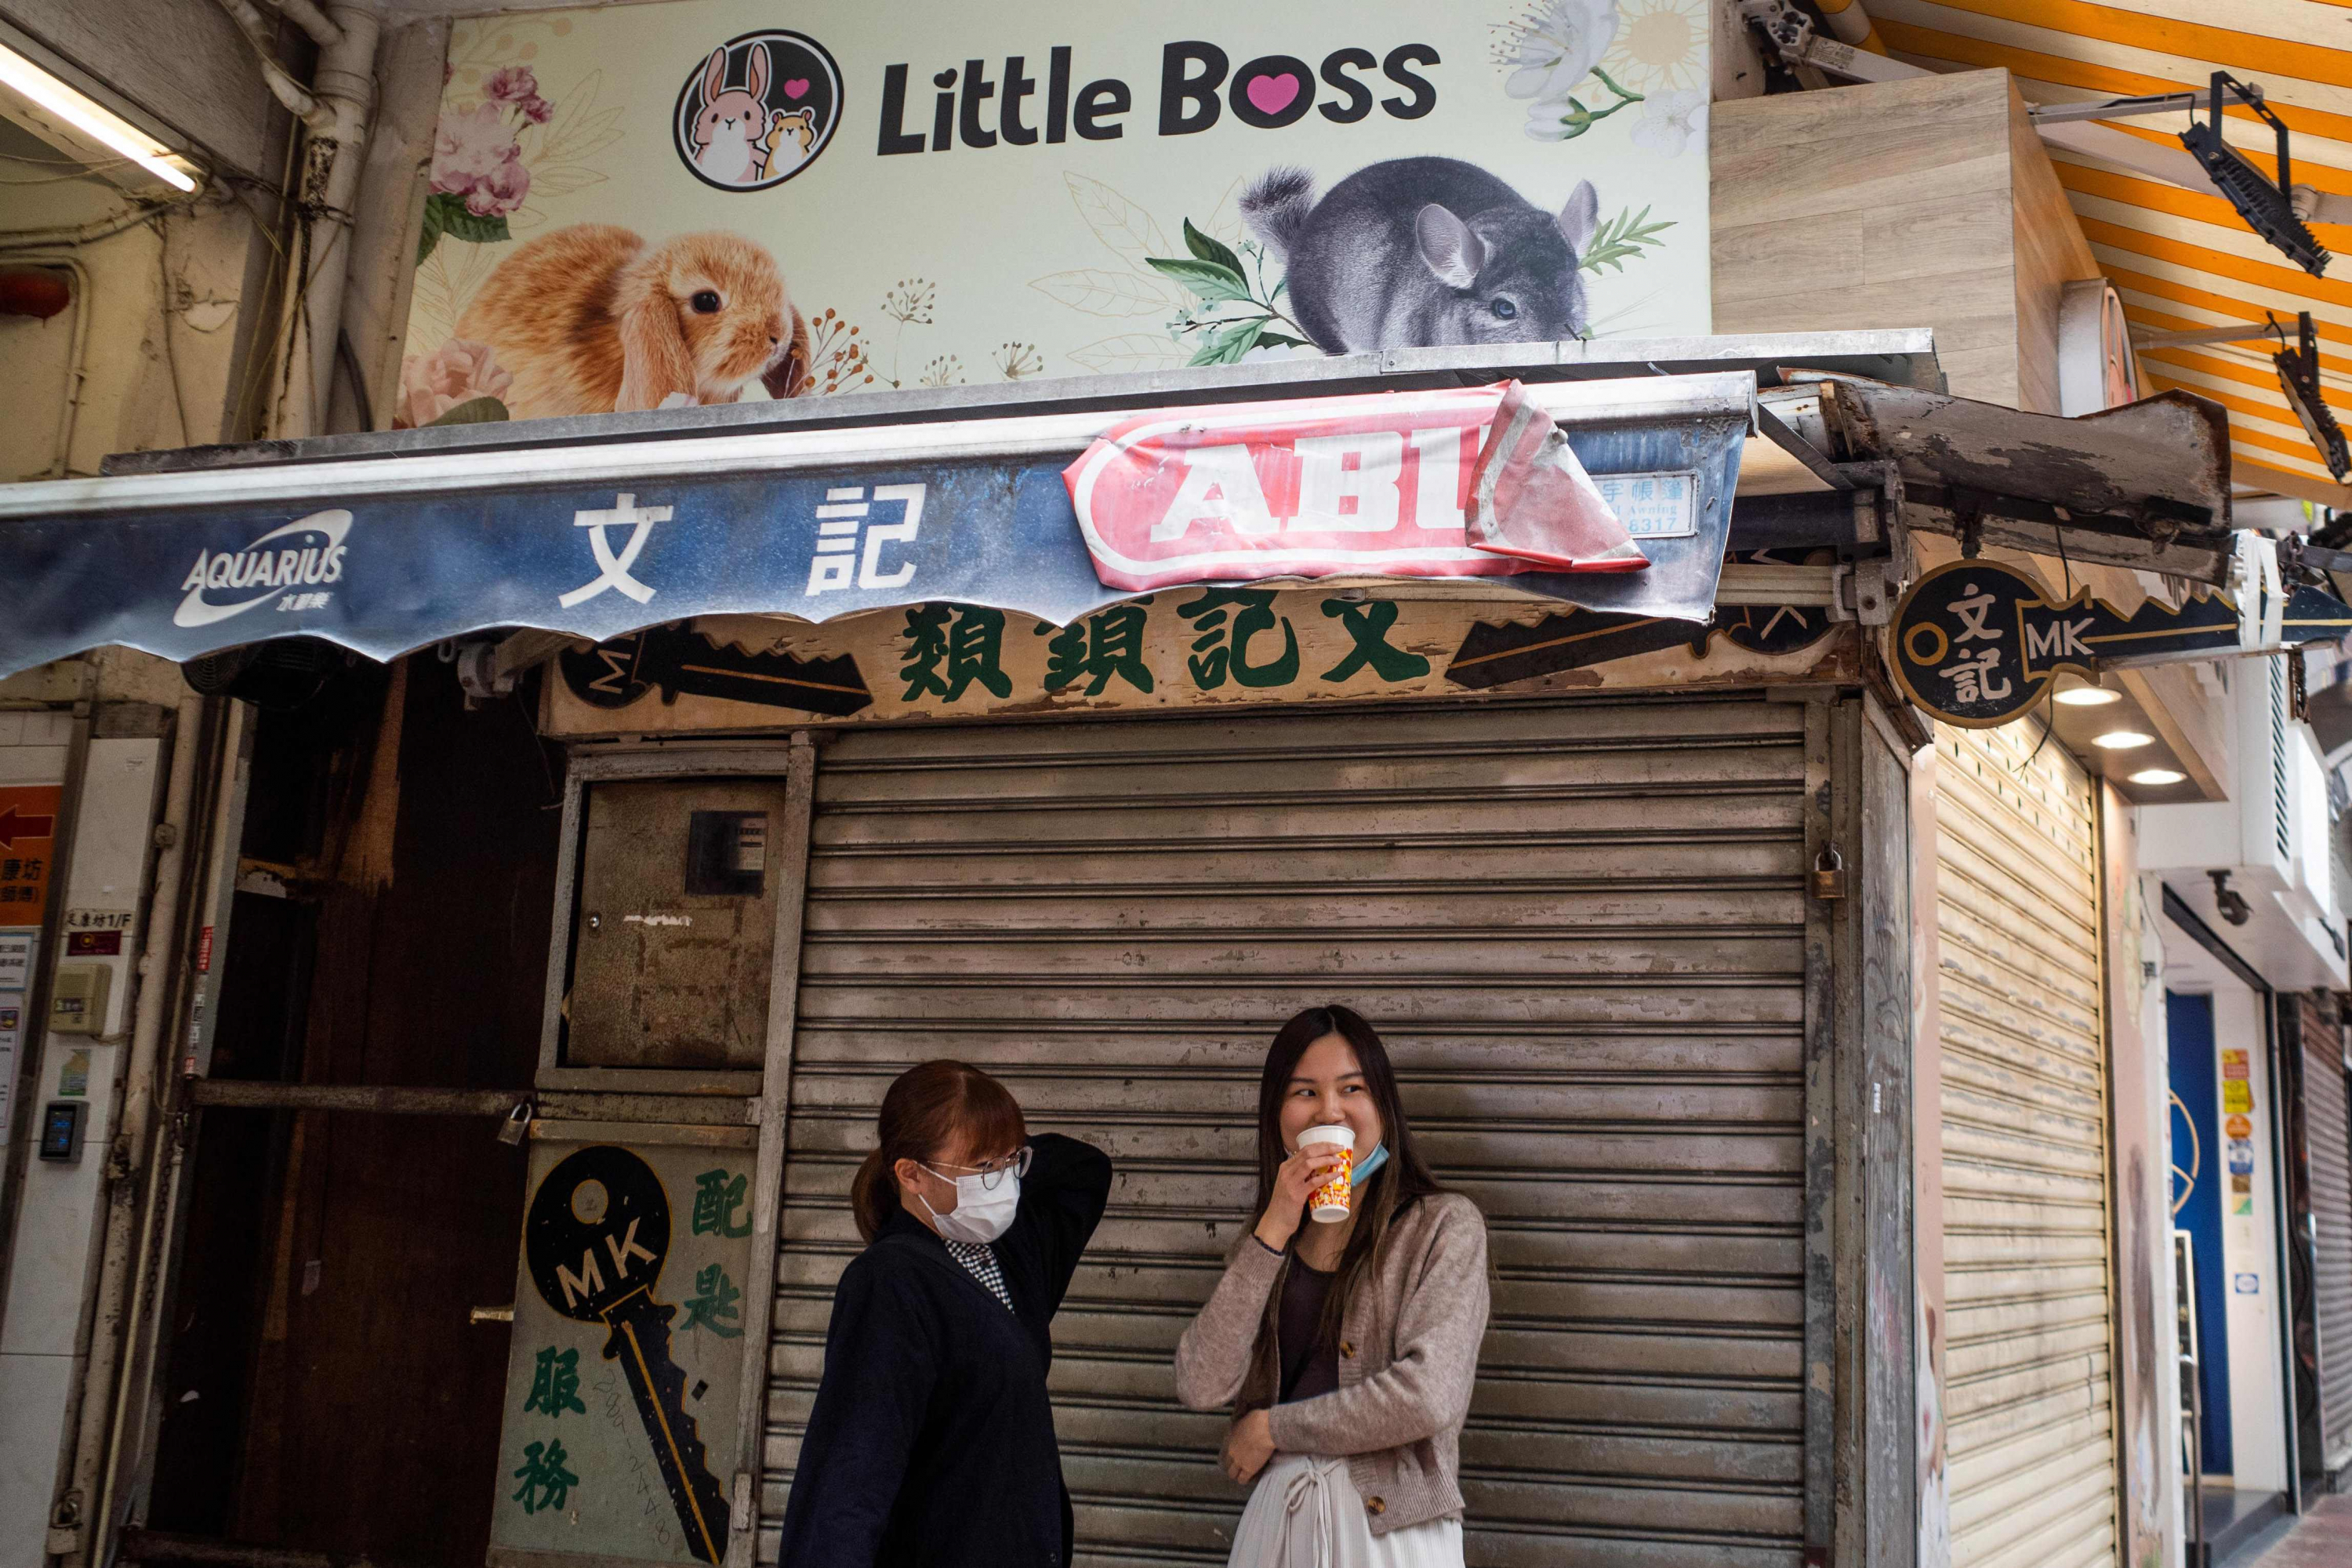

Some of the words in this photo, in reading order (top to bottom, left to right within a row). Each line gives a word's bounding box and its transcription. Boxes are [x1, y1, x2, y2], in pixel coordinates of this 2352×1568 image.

[877, 45, 1131, 156] Little
[557, 481, 926, 608] 文記
[1938, 583, 2013, 704] 文記
[2024, 616, 2096, 659] MK
[555, 1216, 657, 1310] MK
[679, 1168, 753, 1339] 配匙
[511, 1345, 587, 1516] 服務
